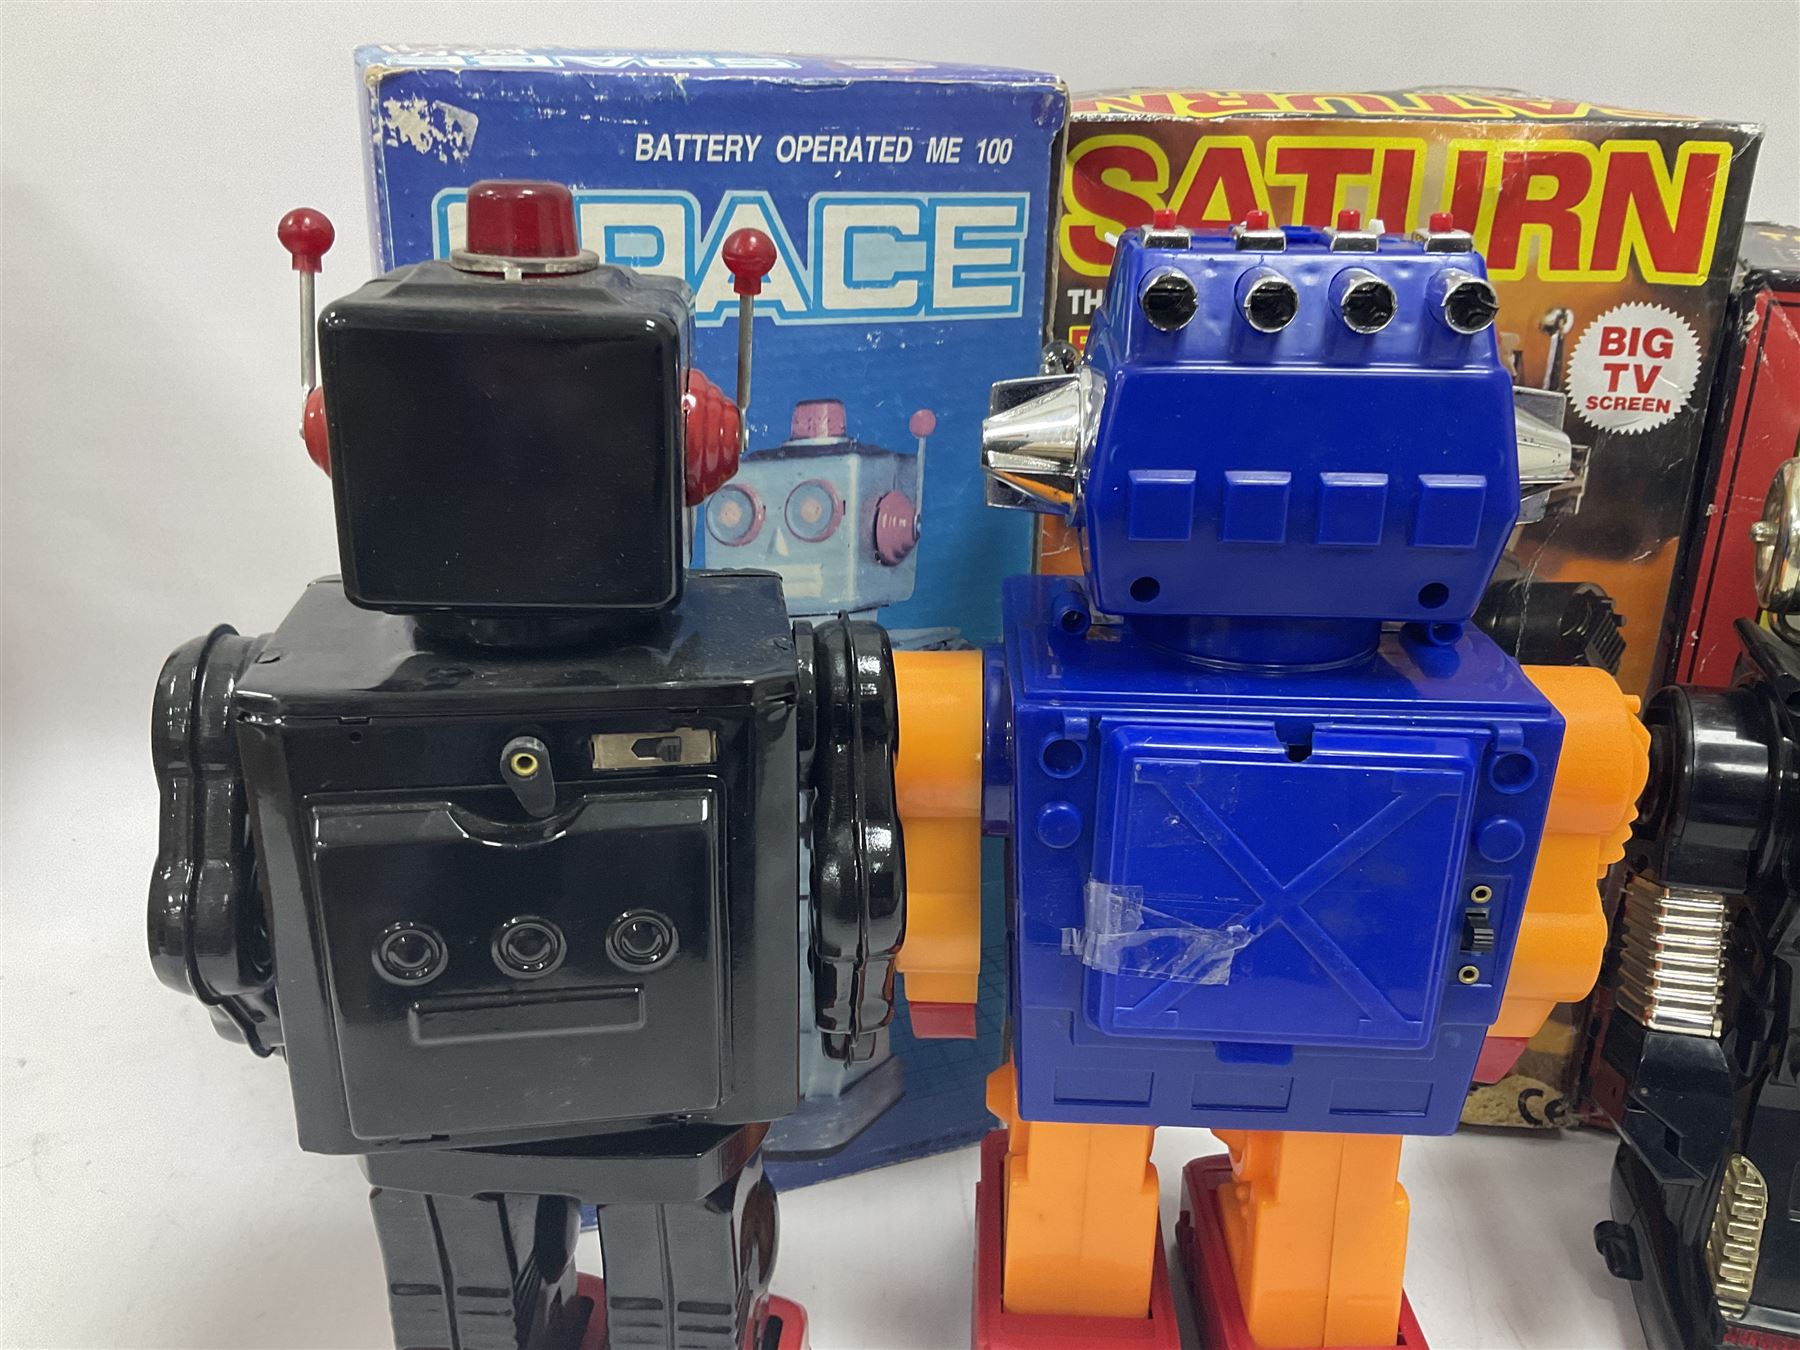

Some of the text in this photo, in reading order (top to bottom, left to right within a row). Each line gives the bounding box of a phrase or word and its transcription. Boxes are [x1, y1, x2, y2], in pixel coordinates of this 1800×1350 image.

[635, 133, 1013, 165] BATTERY OPERATED ME 100
[432, 187, 1030, 327] PACE
[1067, 289, 1104, 315] TH
[1599, 326, 1675, 360] BIG
[1603, 363, 1662, 394] TV
[1586, 395, 1671, 414] SCREEN
